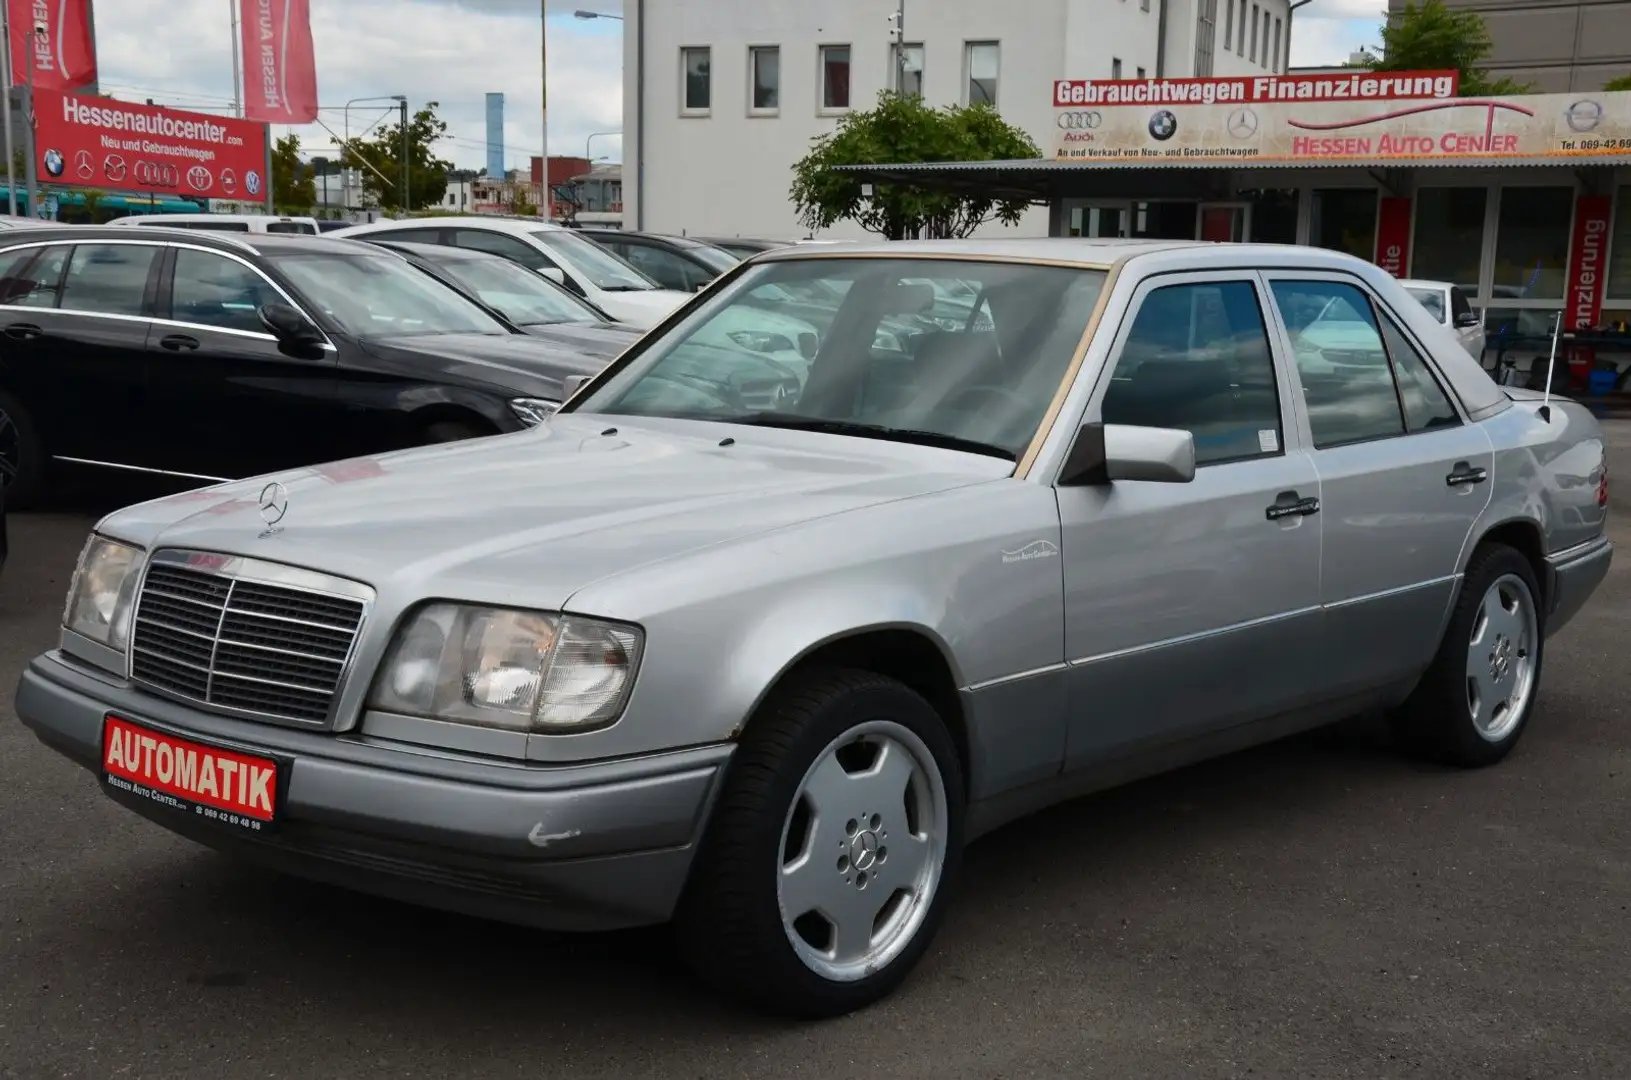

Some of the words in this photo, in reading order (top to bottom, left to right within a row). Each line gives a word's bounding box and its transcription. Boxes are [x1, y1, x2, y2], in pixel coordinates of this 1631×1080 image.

[1057, 78, 1245, 104] Gebrauchtwagen
[1252, 75, 1453, 100] Finanzierung
[101, 135, 120, 149] Neu
[122, 140, 141, 152] und
[142, 140, 215, 162] Gebrauchtwagen
[1057, 148, 1068, 156] An
[1070, 148, 1086, 156] und
[1088, 147, 1121, 156] Verkauf
[1165, 148, 1182, 156] und
[1184, 147, 1259, 157] Gebrauchtwagen
[1292, 135, 1372, 155] HESSEN
[1376, 132, 1435, 154] AUTO
[1561, 140, 1577, 150] Tel.
[107, 726, 274, 812] AUTOMATIK
